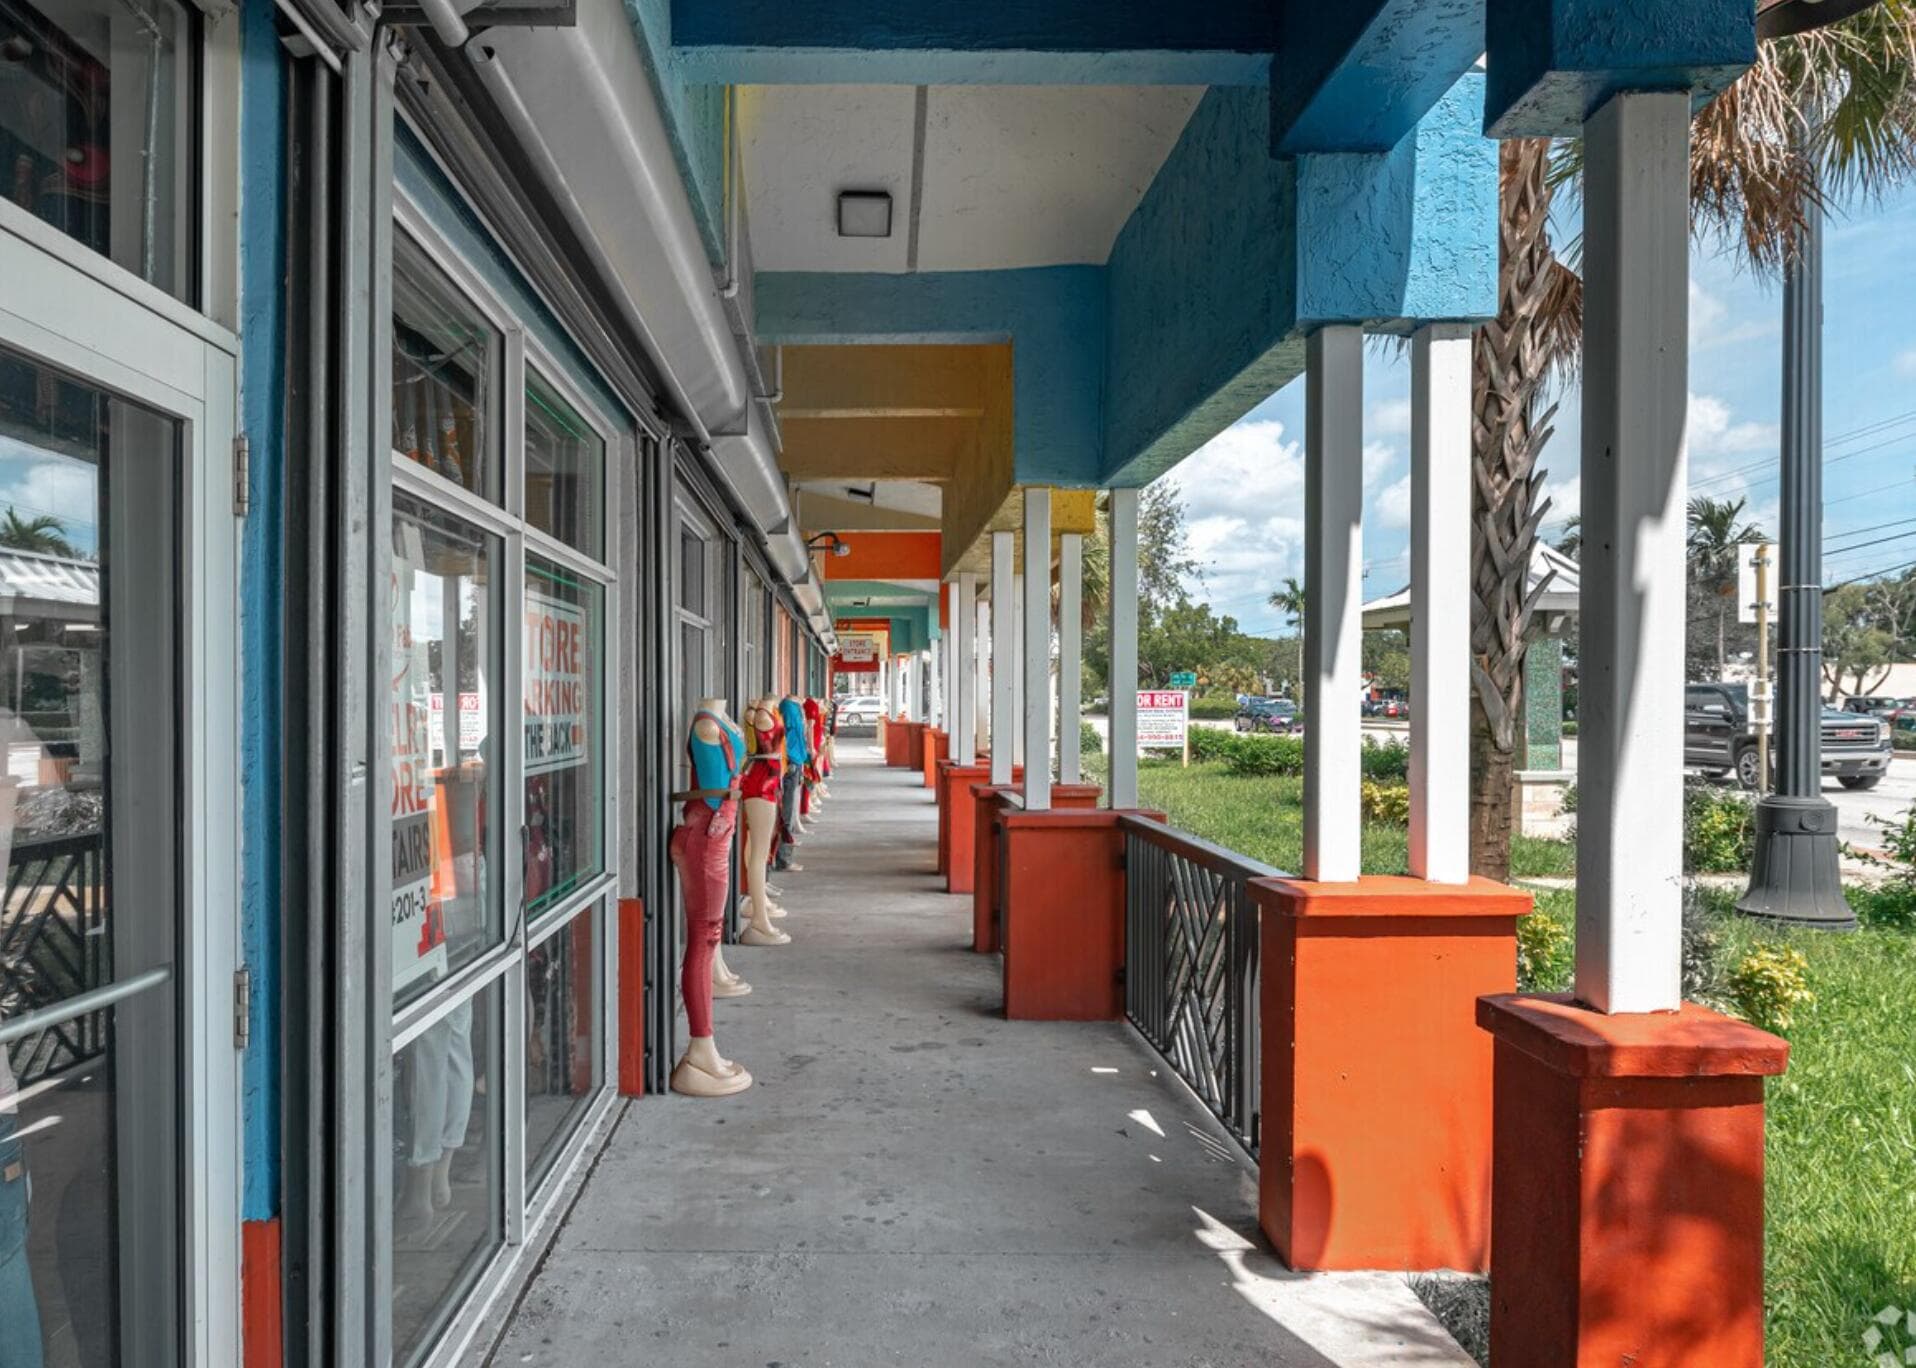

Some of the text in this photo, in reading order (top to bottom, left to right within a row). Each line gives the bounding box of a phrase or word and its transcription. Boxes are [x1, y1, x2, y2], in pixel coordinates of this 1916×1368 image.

[849, 639, 866, 647] STORE
[1137, 694, 1183, 707] OR RENT
